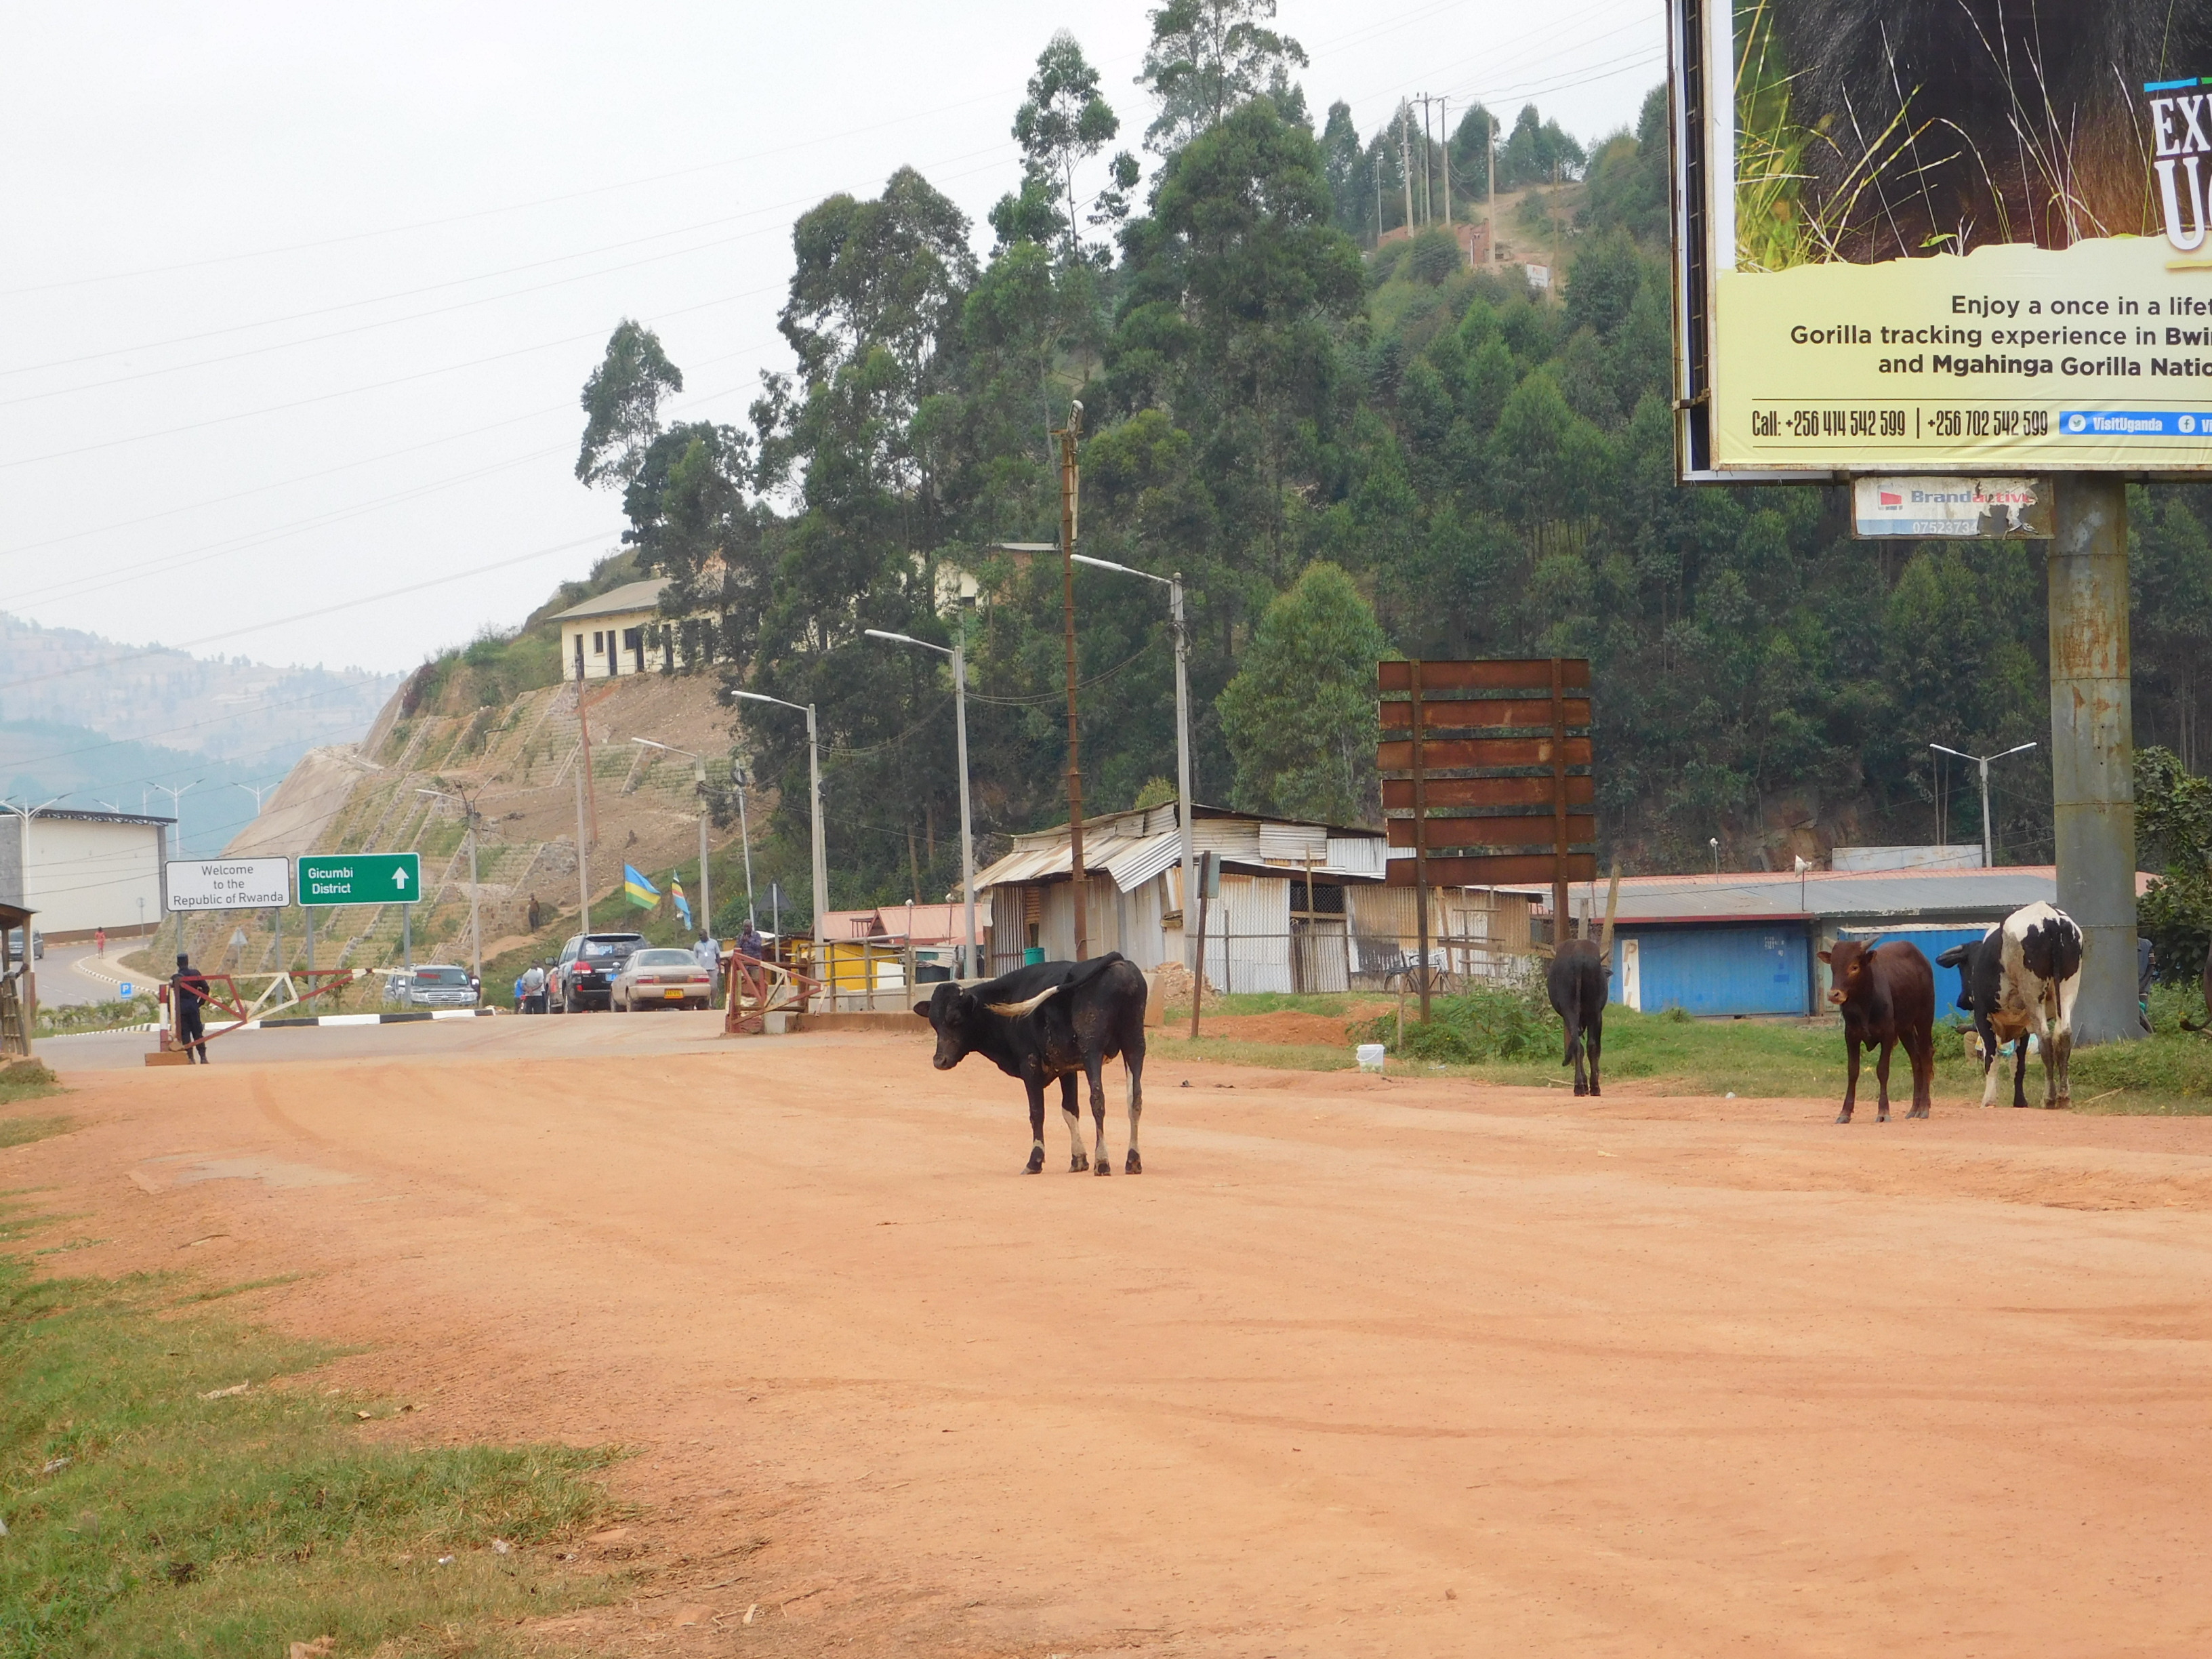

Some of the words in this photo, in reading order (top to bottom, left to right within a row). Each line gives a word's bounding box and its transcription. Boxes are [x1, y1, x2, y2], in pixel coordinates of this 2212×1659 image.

[2150, 94, 2212, 157] EX
[2154, 156, 2212, 250] U
[1952, 295, 2020, 319] Enjoy
[2028, 300, 2041, 314] a
[2051, 300, 2109, 315] once
[2118, 296, 2139, 315] in
[2147, 301, 2160, 315] a
[1790, 325, 1872, 344] Gorilla
[1881, 325, 1982, 348] tracking
[1991, 326, 2127, 348] experience
[2136, 326, 2156, 345] in
[2165, 327, 2212, 346] Bwi
[1878, 354, 1923, 373] and
[1933, 354, 2053, 377] Mgahinga
[2061, 356, 2141, 376] Gorilla
[1752, 410, 1782, 436] Call:
[1786, 410, 1819, 436] +256
[1823, 410, 1846, 436] 414
[1850, 410, 1876, 436] 542
[1880, 410, 1905, 436] 599
[1927, 410, 1961, 436] +256
[1966, 410, 1989, 436] 702
[1993, 410, 2019, 436] 542
[2023, 410, 2048, 436] 599
[2093, 417, 2163, 432] VisitUganda
[201, 865, 253, 876] Welcome
[308, 867, 354, 879] Gicumbi
[213, 880, 224, 889] to
[228, 880, 245, 888] the
[312, 883, 351, 894] District
[173, 895, 222, 907] Republic
[226, 894, 237, 904] of
[239, 892, 283, 903] Rwanda
[123, 985, 129, 993] P
